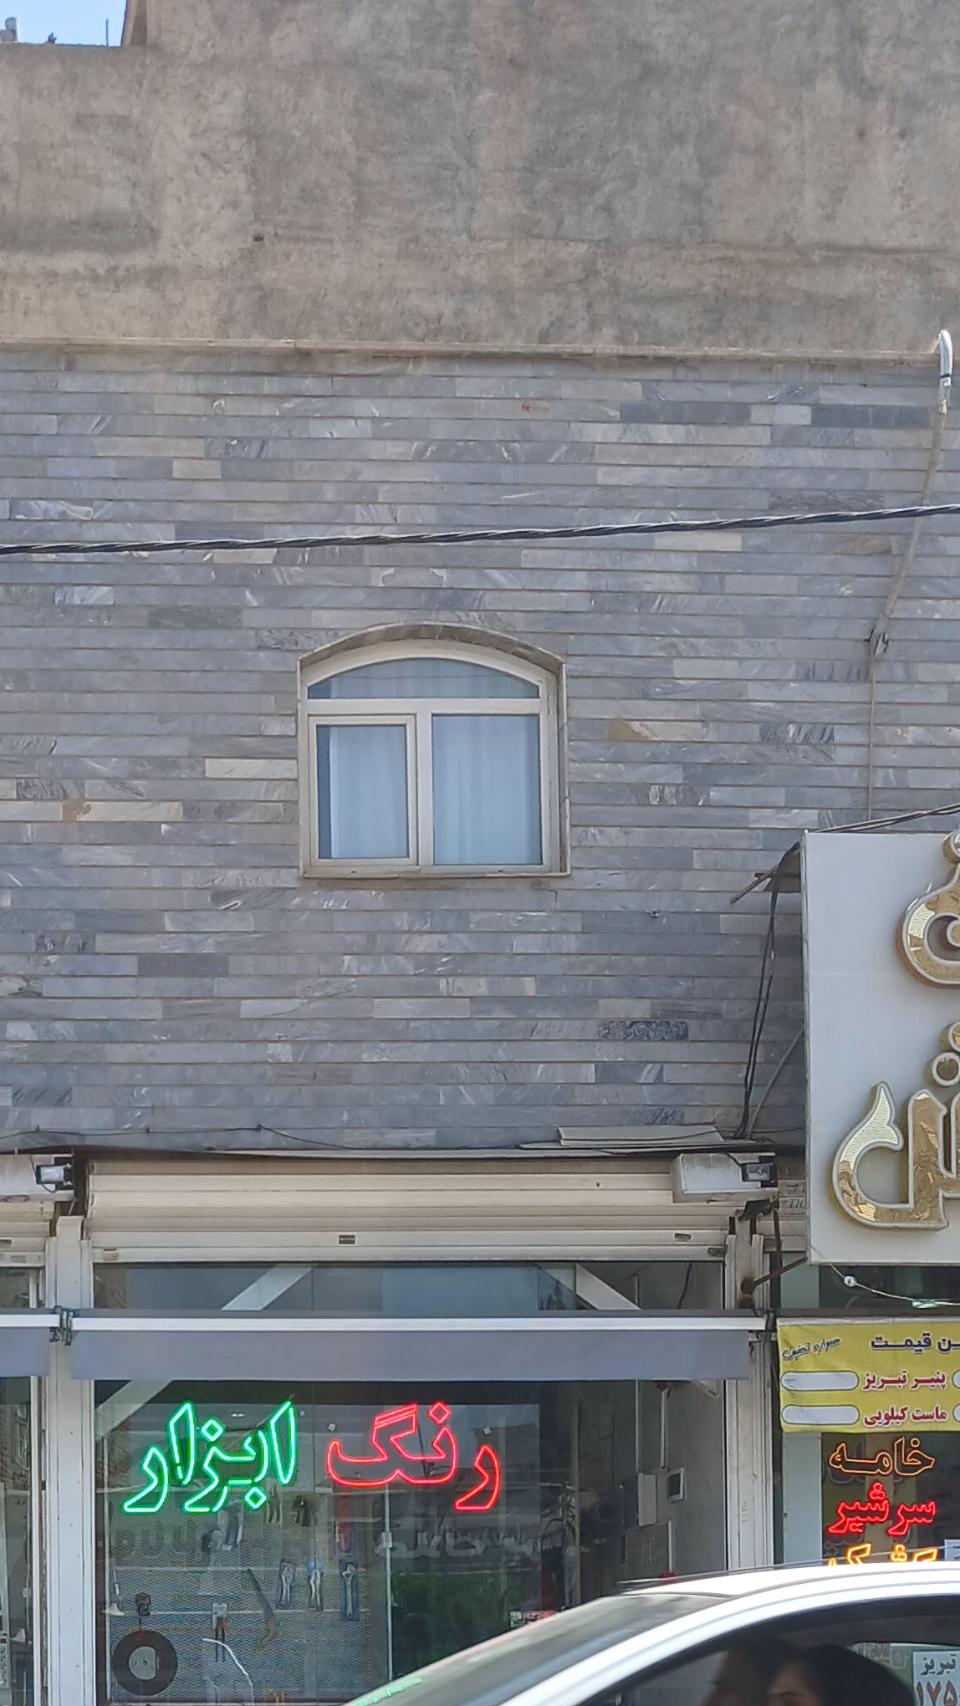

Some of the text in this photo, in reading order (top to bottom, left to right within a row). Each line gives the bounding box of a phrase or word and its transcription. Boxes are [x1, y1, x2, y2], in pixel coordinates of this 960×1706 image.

[871, 1333, 932, 1354] قیمت
[862, 1371, 947, 1390] پنیر تبریز
[863, 1406, 948, 1427] ماست کیلویی
[123, 1400, 501, 1513] رنگ ابزار
[828, 1437, 936, 1476] خامه
[920, 1653, 958, 1676] تبریز
